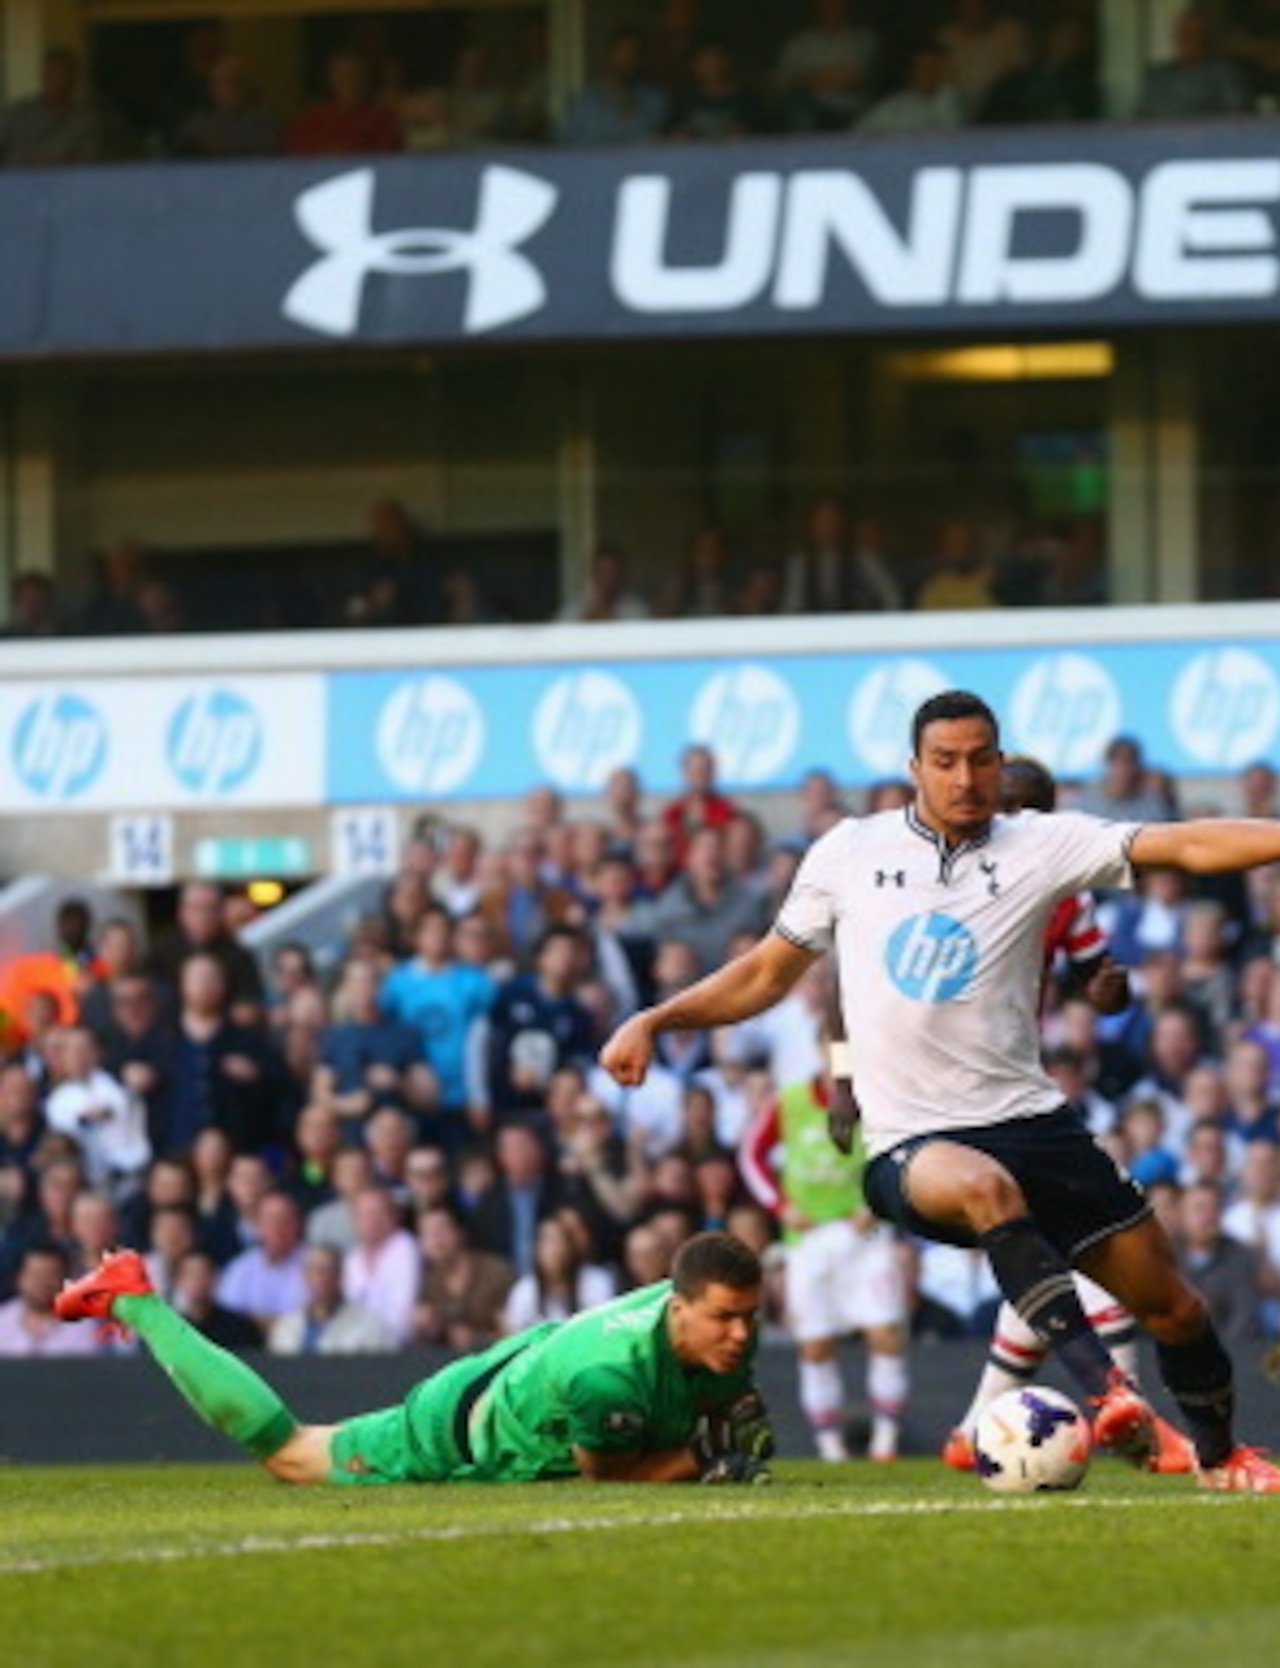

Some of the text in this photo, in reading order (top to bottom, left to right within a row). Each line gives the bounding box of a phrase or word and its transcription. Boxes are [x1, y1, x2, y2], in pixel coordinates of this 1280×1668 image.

[15, 686, 103, 797] hp
[169, 683, 260, 794] hp
[382, 675, 482, 796] hp
[539, 670, 638, 790] hp
[694, 664, 795, 785] hp
[1014, 652, 1116, 772] hp
[1175, 647, 1279, 766] hp
[890, 911, 975, 1003] hp
